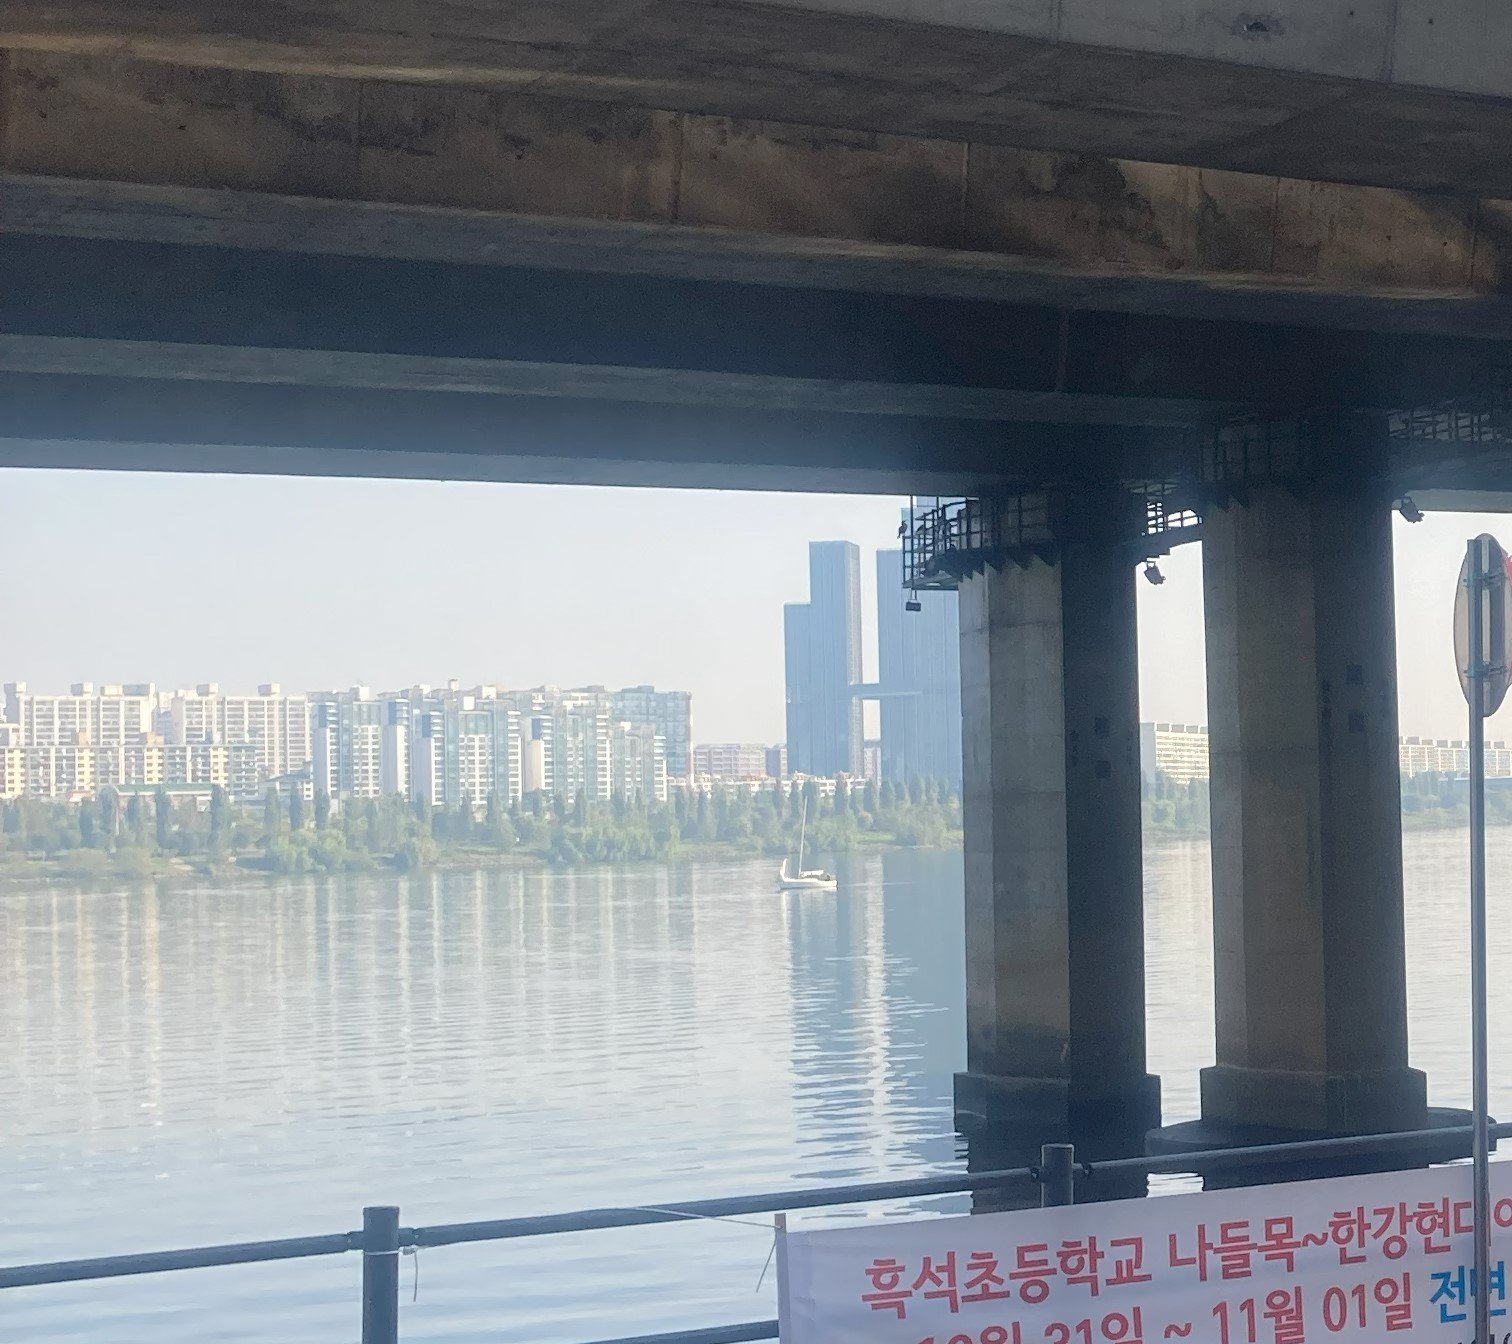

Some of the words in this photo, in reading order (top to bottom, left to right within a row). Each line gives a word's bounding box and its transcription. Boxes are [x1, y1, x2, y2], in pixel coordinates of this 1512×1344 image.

[861, 1236, 1153, 1320] 흑석초등학교
[1163, 1321, 1193, 1339] ~
[1321, 1271, 1413, 1332] 01일
